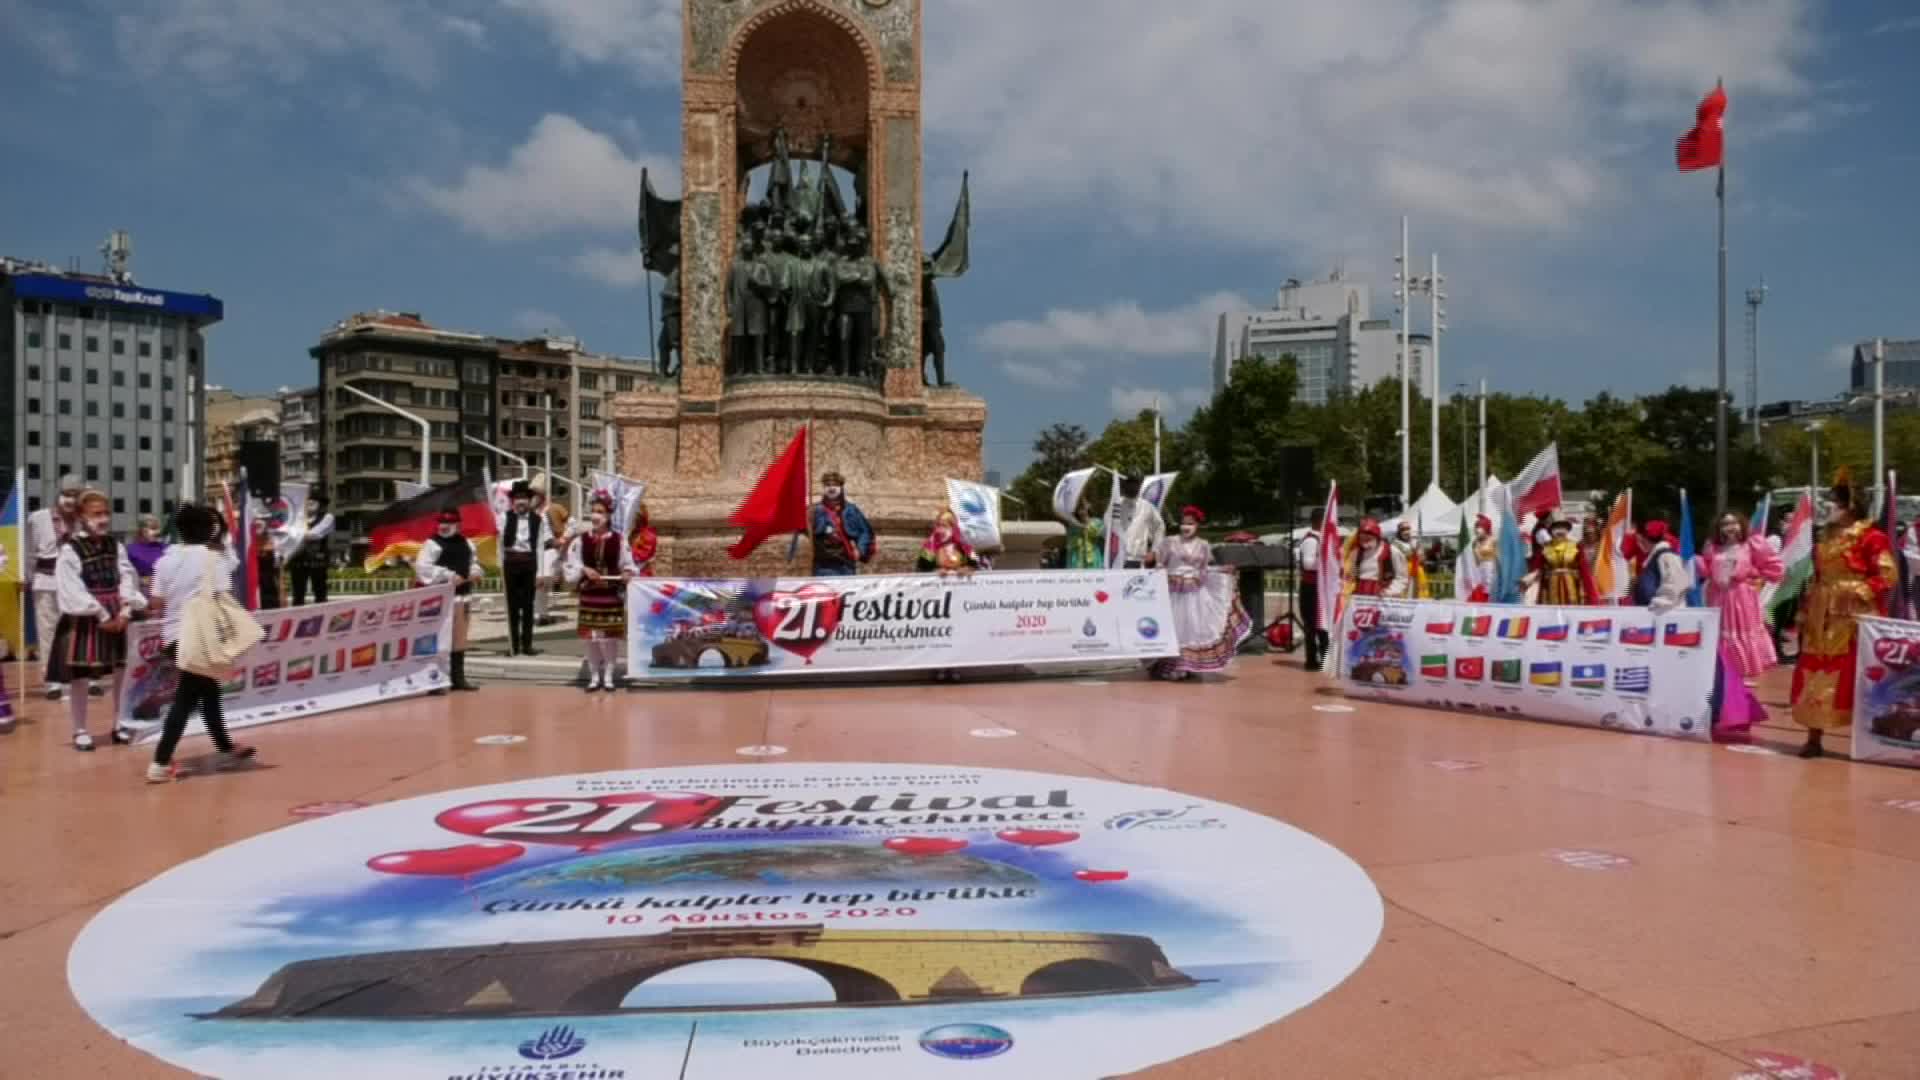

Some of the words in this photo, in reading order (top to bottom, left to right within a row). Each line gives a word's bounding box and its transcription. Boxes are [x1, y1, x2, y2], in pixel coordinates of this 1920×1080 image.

[772, 597, 827, 640] 21.
[838, 590, 953, 622] Festival
[1015, 614, 1047, 628] 2020
[834, 622, 953, 645] Büyükçekmece
[482, 801, 664, 833] 21.
[702, 789, 1073, 818] Festival
[690, 811, 1086, 831] Büyükçekmece
[482, 897, 625, 915] Çünkü
[636, 893, 792, 910] kalpler
[802, 891, 875, 907] hep
[886, 887, 1035, 902] birlikte
[606, 914, 643, 925] 10
[823, 906, 917, 919] 2020
